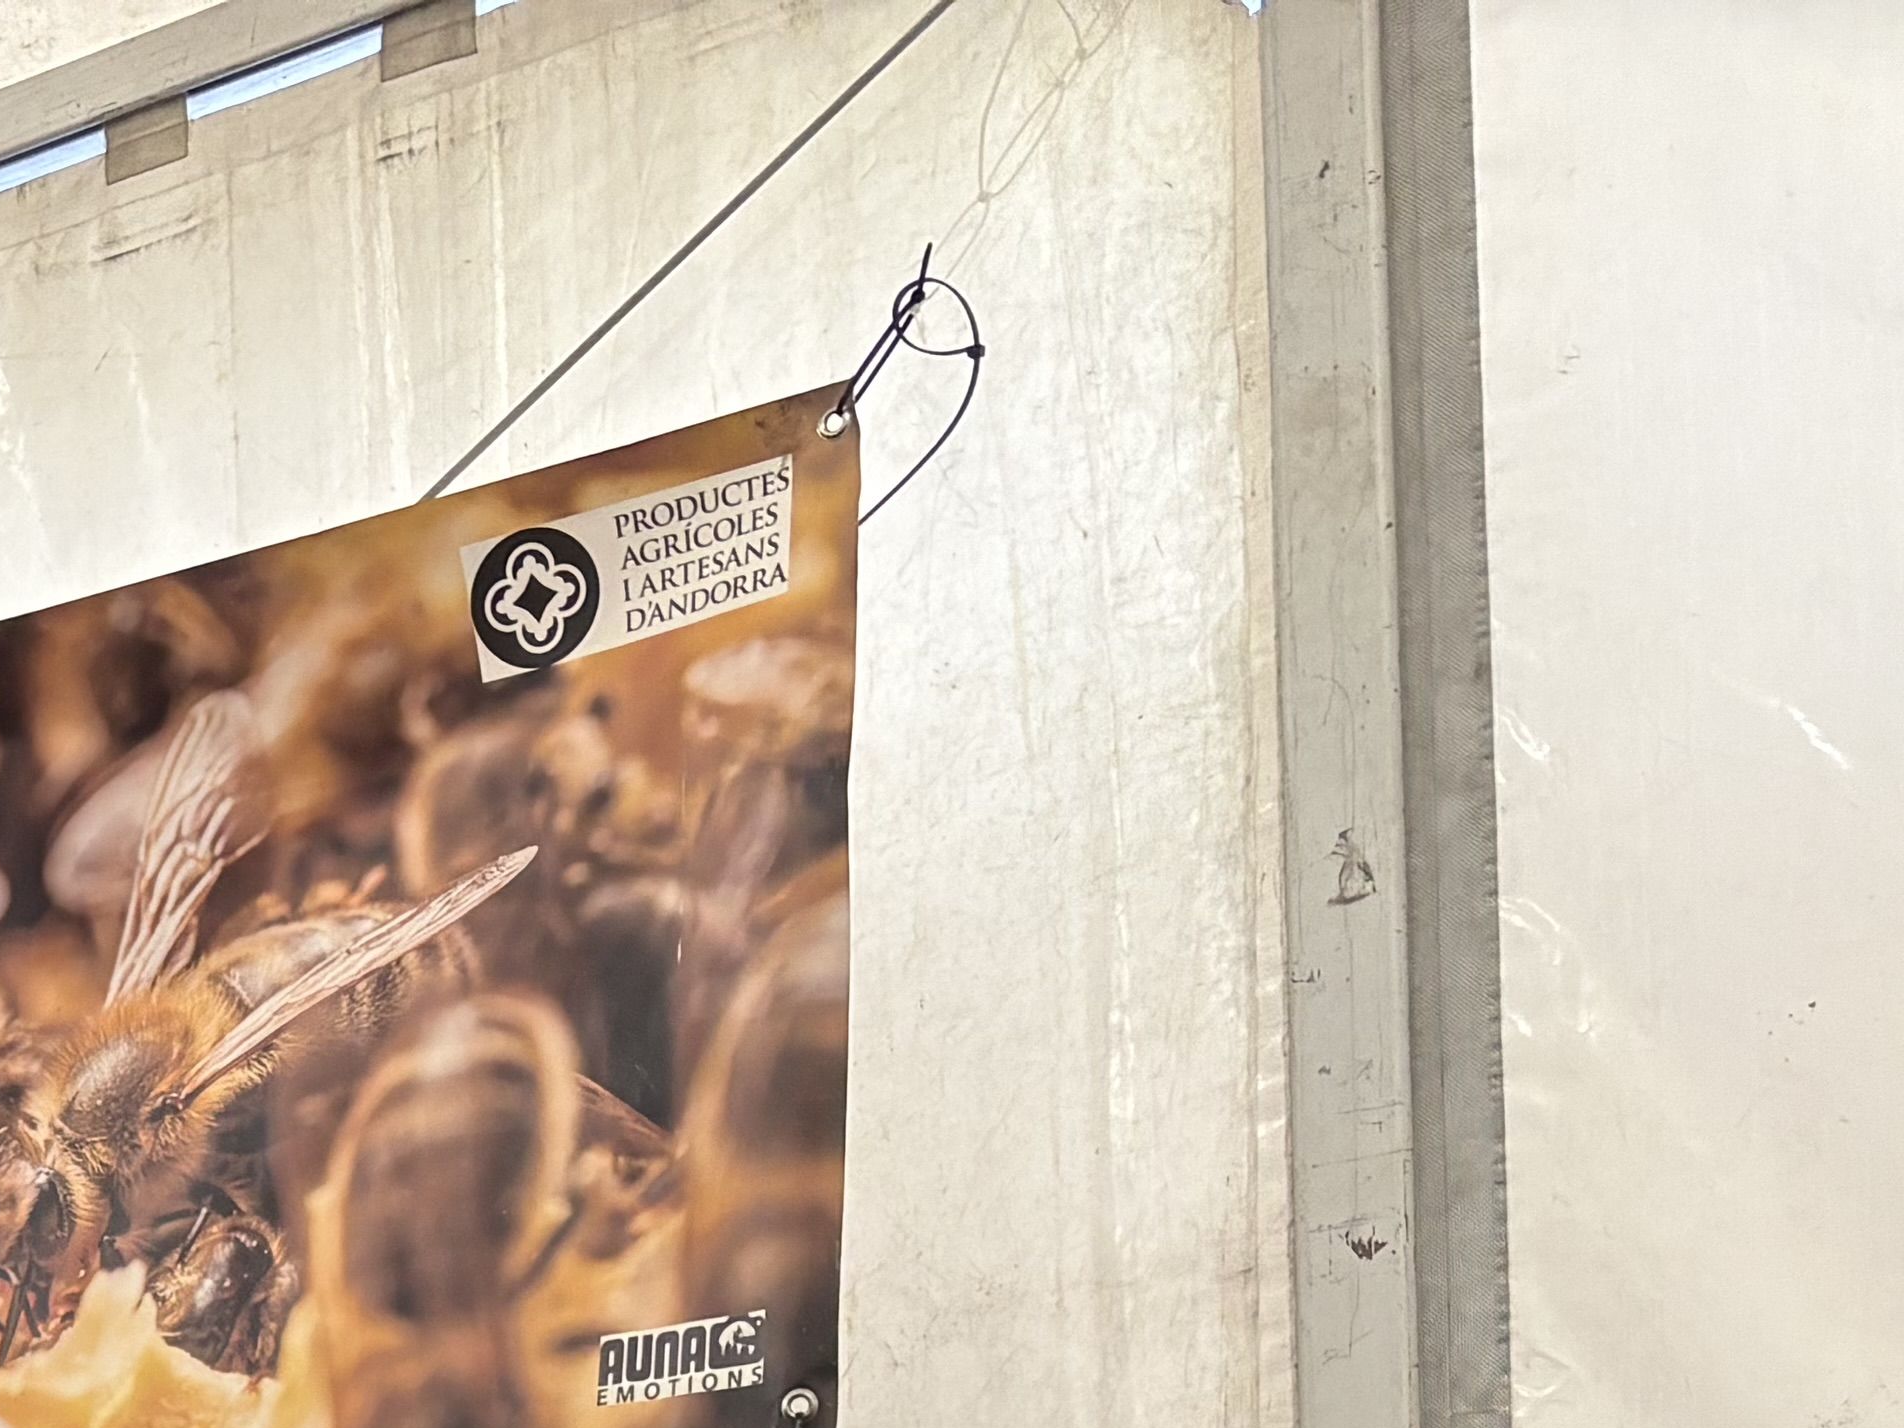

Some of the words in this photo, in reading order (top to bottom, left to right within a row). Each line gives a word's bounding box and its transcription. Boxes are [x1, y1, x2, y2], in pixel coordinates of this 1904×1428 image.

[613, 466, 790, 538] PRODUCTES
[621, 502, 778, 570] AGRÍCOLES
[623, 579, 631, 601] I
[639, 535, 779, 597] ARTESANS
[626, 563, 787, 632] D'ANDORRA
[597, 1365, 763, 1406] EMOTIONS
